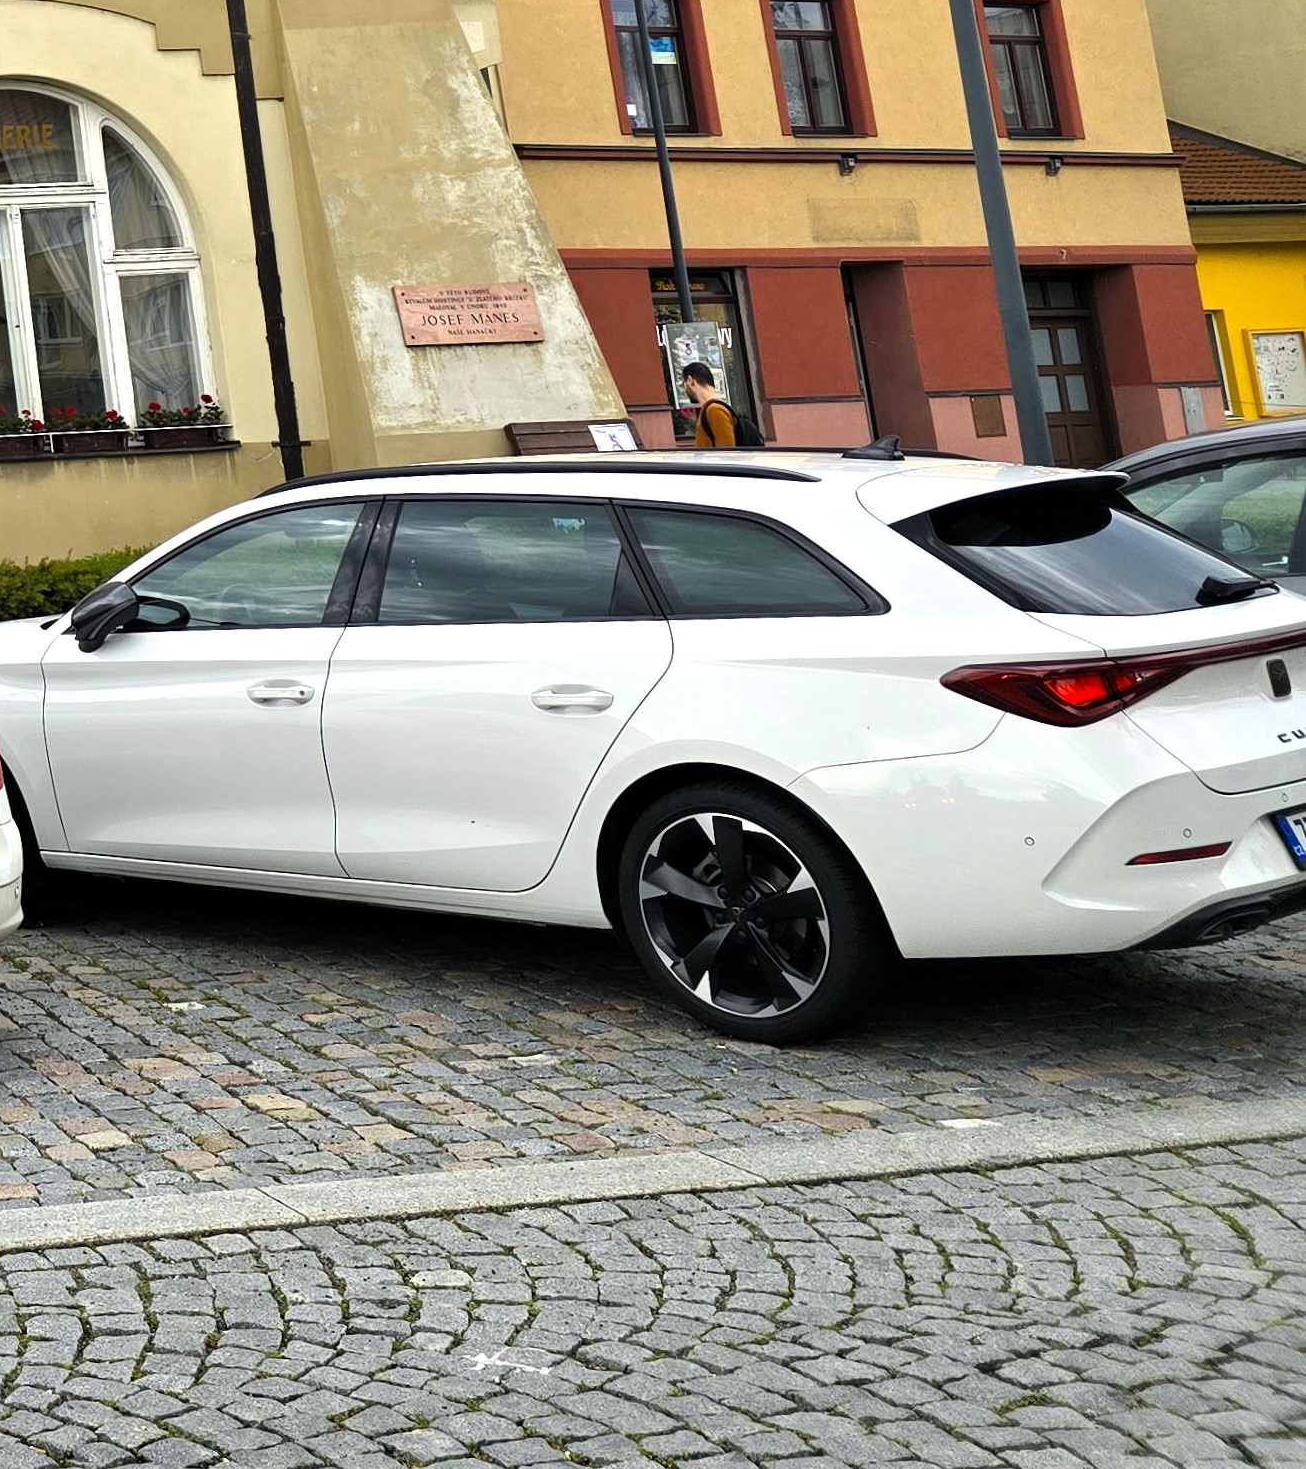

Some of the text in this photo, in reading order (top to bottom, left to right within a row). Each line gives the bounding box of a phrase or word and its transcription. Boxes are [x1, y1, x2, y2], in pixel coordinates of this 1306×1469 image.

[422, 312, 520, 326] JOSEF MÁNES
[1277, 727, 1306, 744] CU
